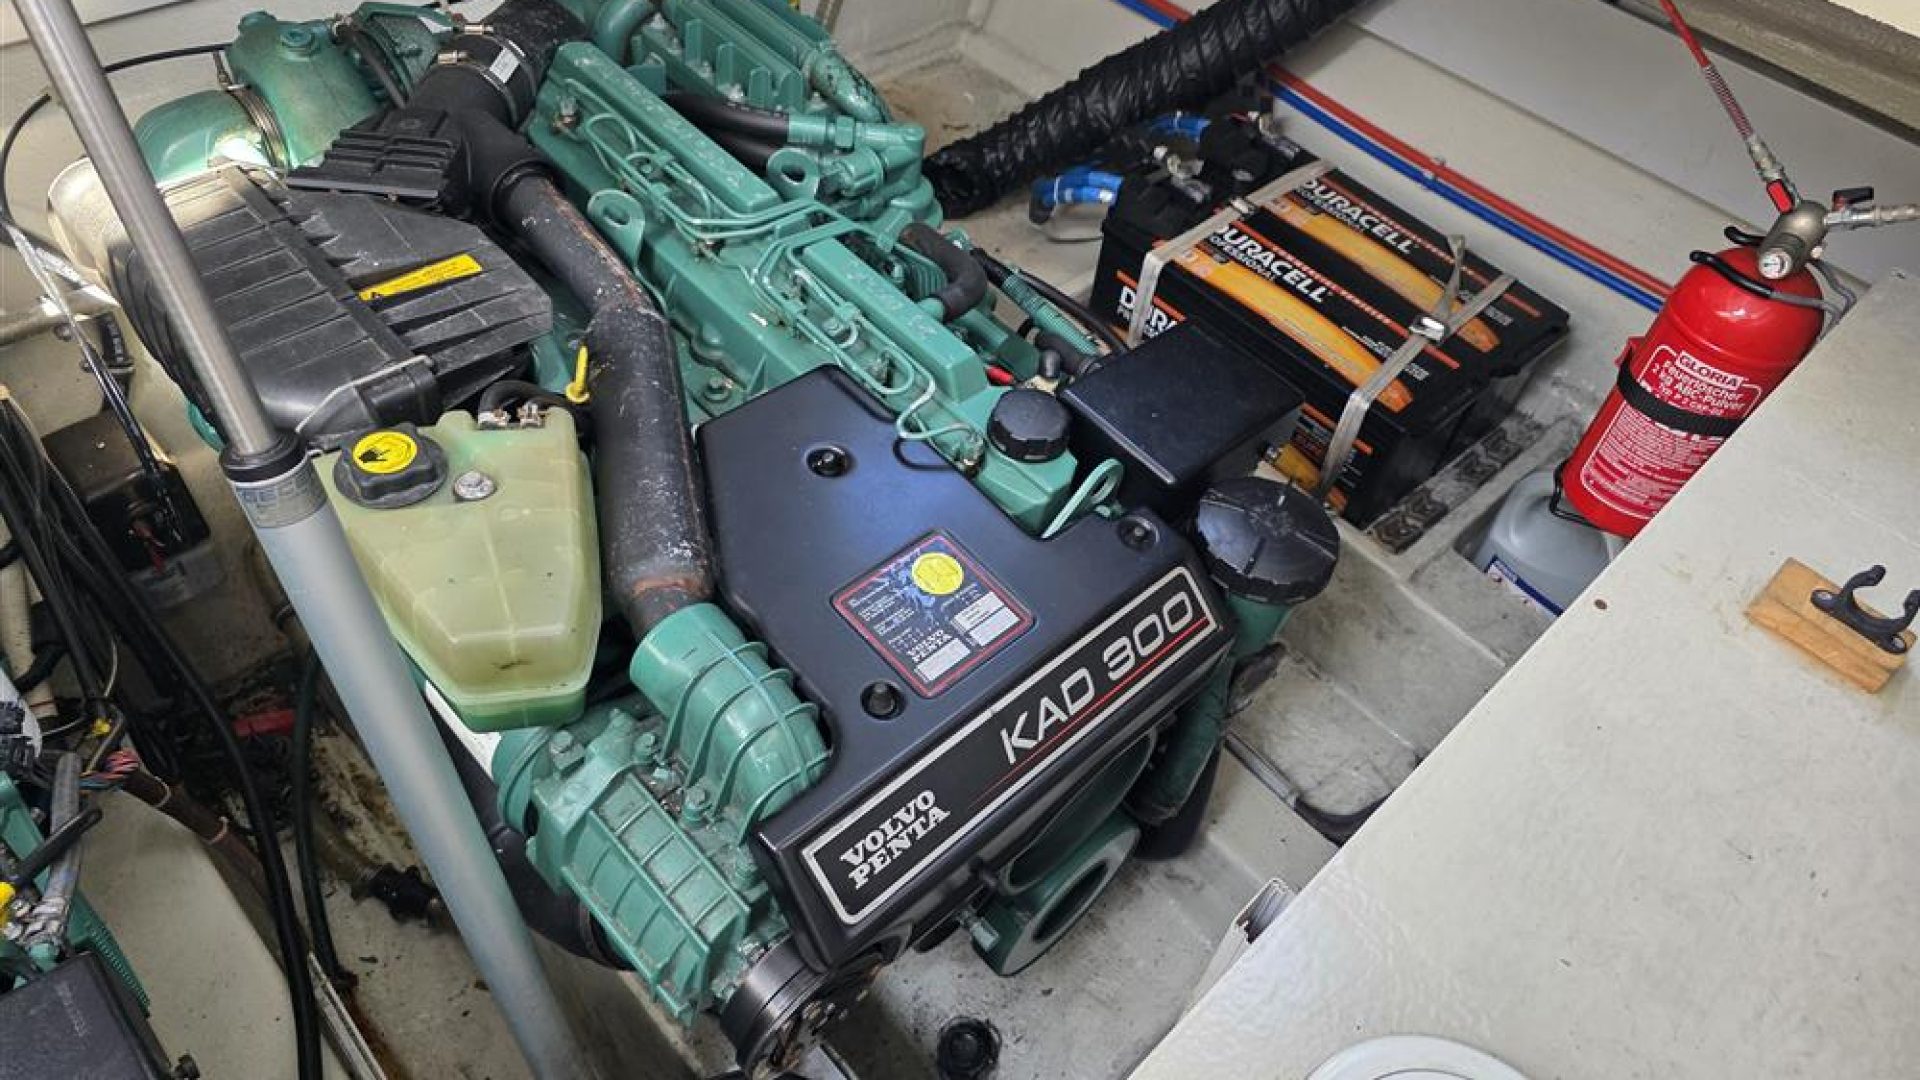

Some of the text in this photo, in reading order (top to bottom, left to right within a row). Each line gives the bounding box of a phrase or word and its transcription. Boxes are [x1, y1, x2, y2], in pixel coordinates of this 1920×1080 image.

[1680, 354, 1738, 387] GLORIA
[1000, 592, 1193, 766] KAD 300
[839, 790, 936, 866] VOLVO
[848, 806, 951, 891] PENTA
